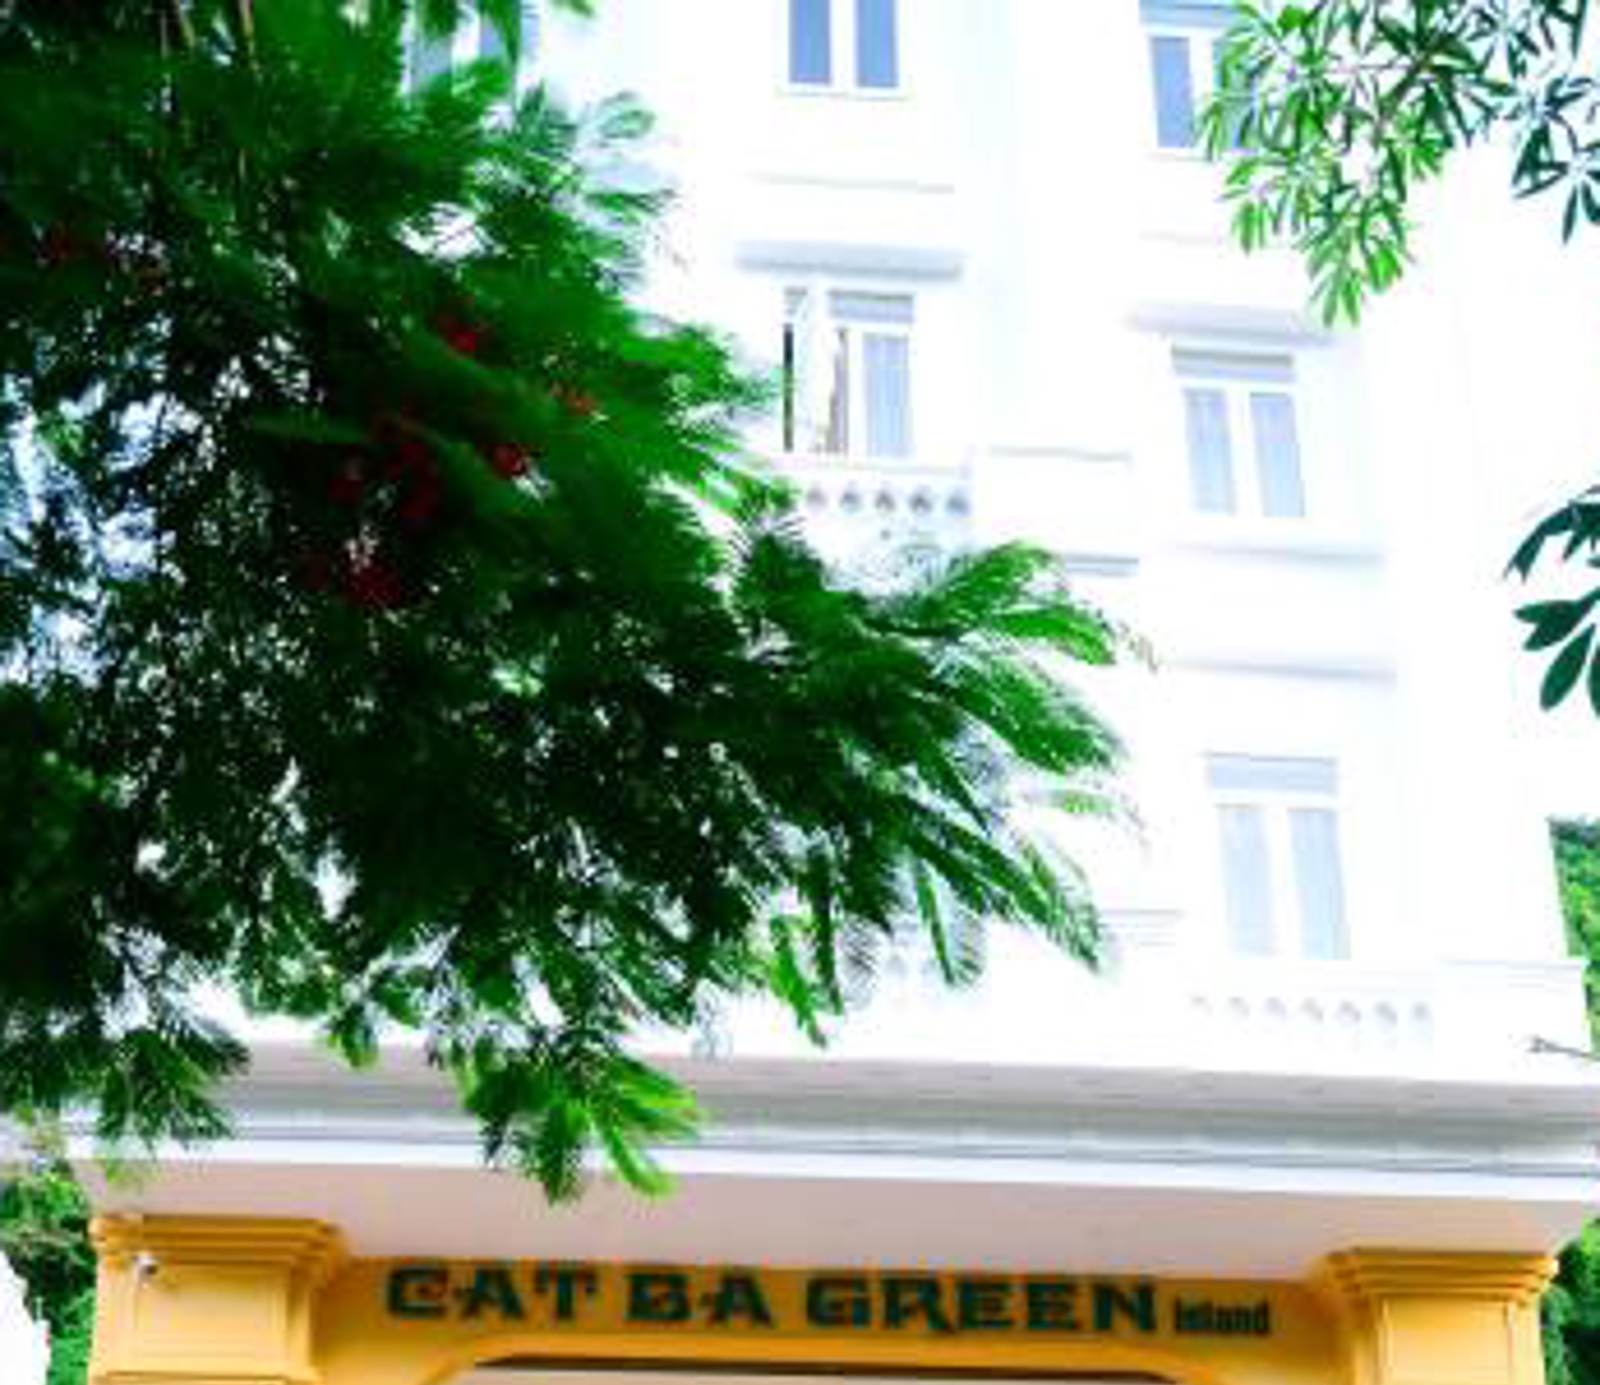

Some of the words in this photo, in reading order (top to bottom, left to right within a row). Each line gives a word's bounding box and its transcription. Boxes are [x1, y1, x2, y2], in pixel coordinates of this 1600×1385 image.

[386, 1266, 600, 1321] CAT
[625, 1269, 774, 1326] BA
[804, 1272, 1158, 1334] GREEN
